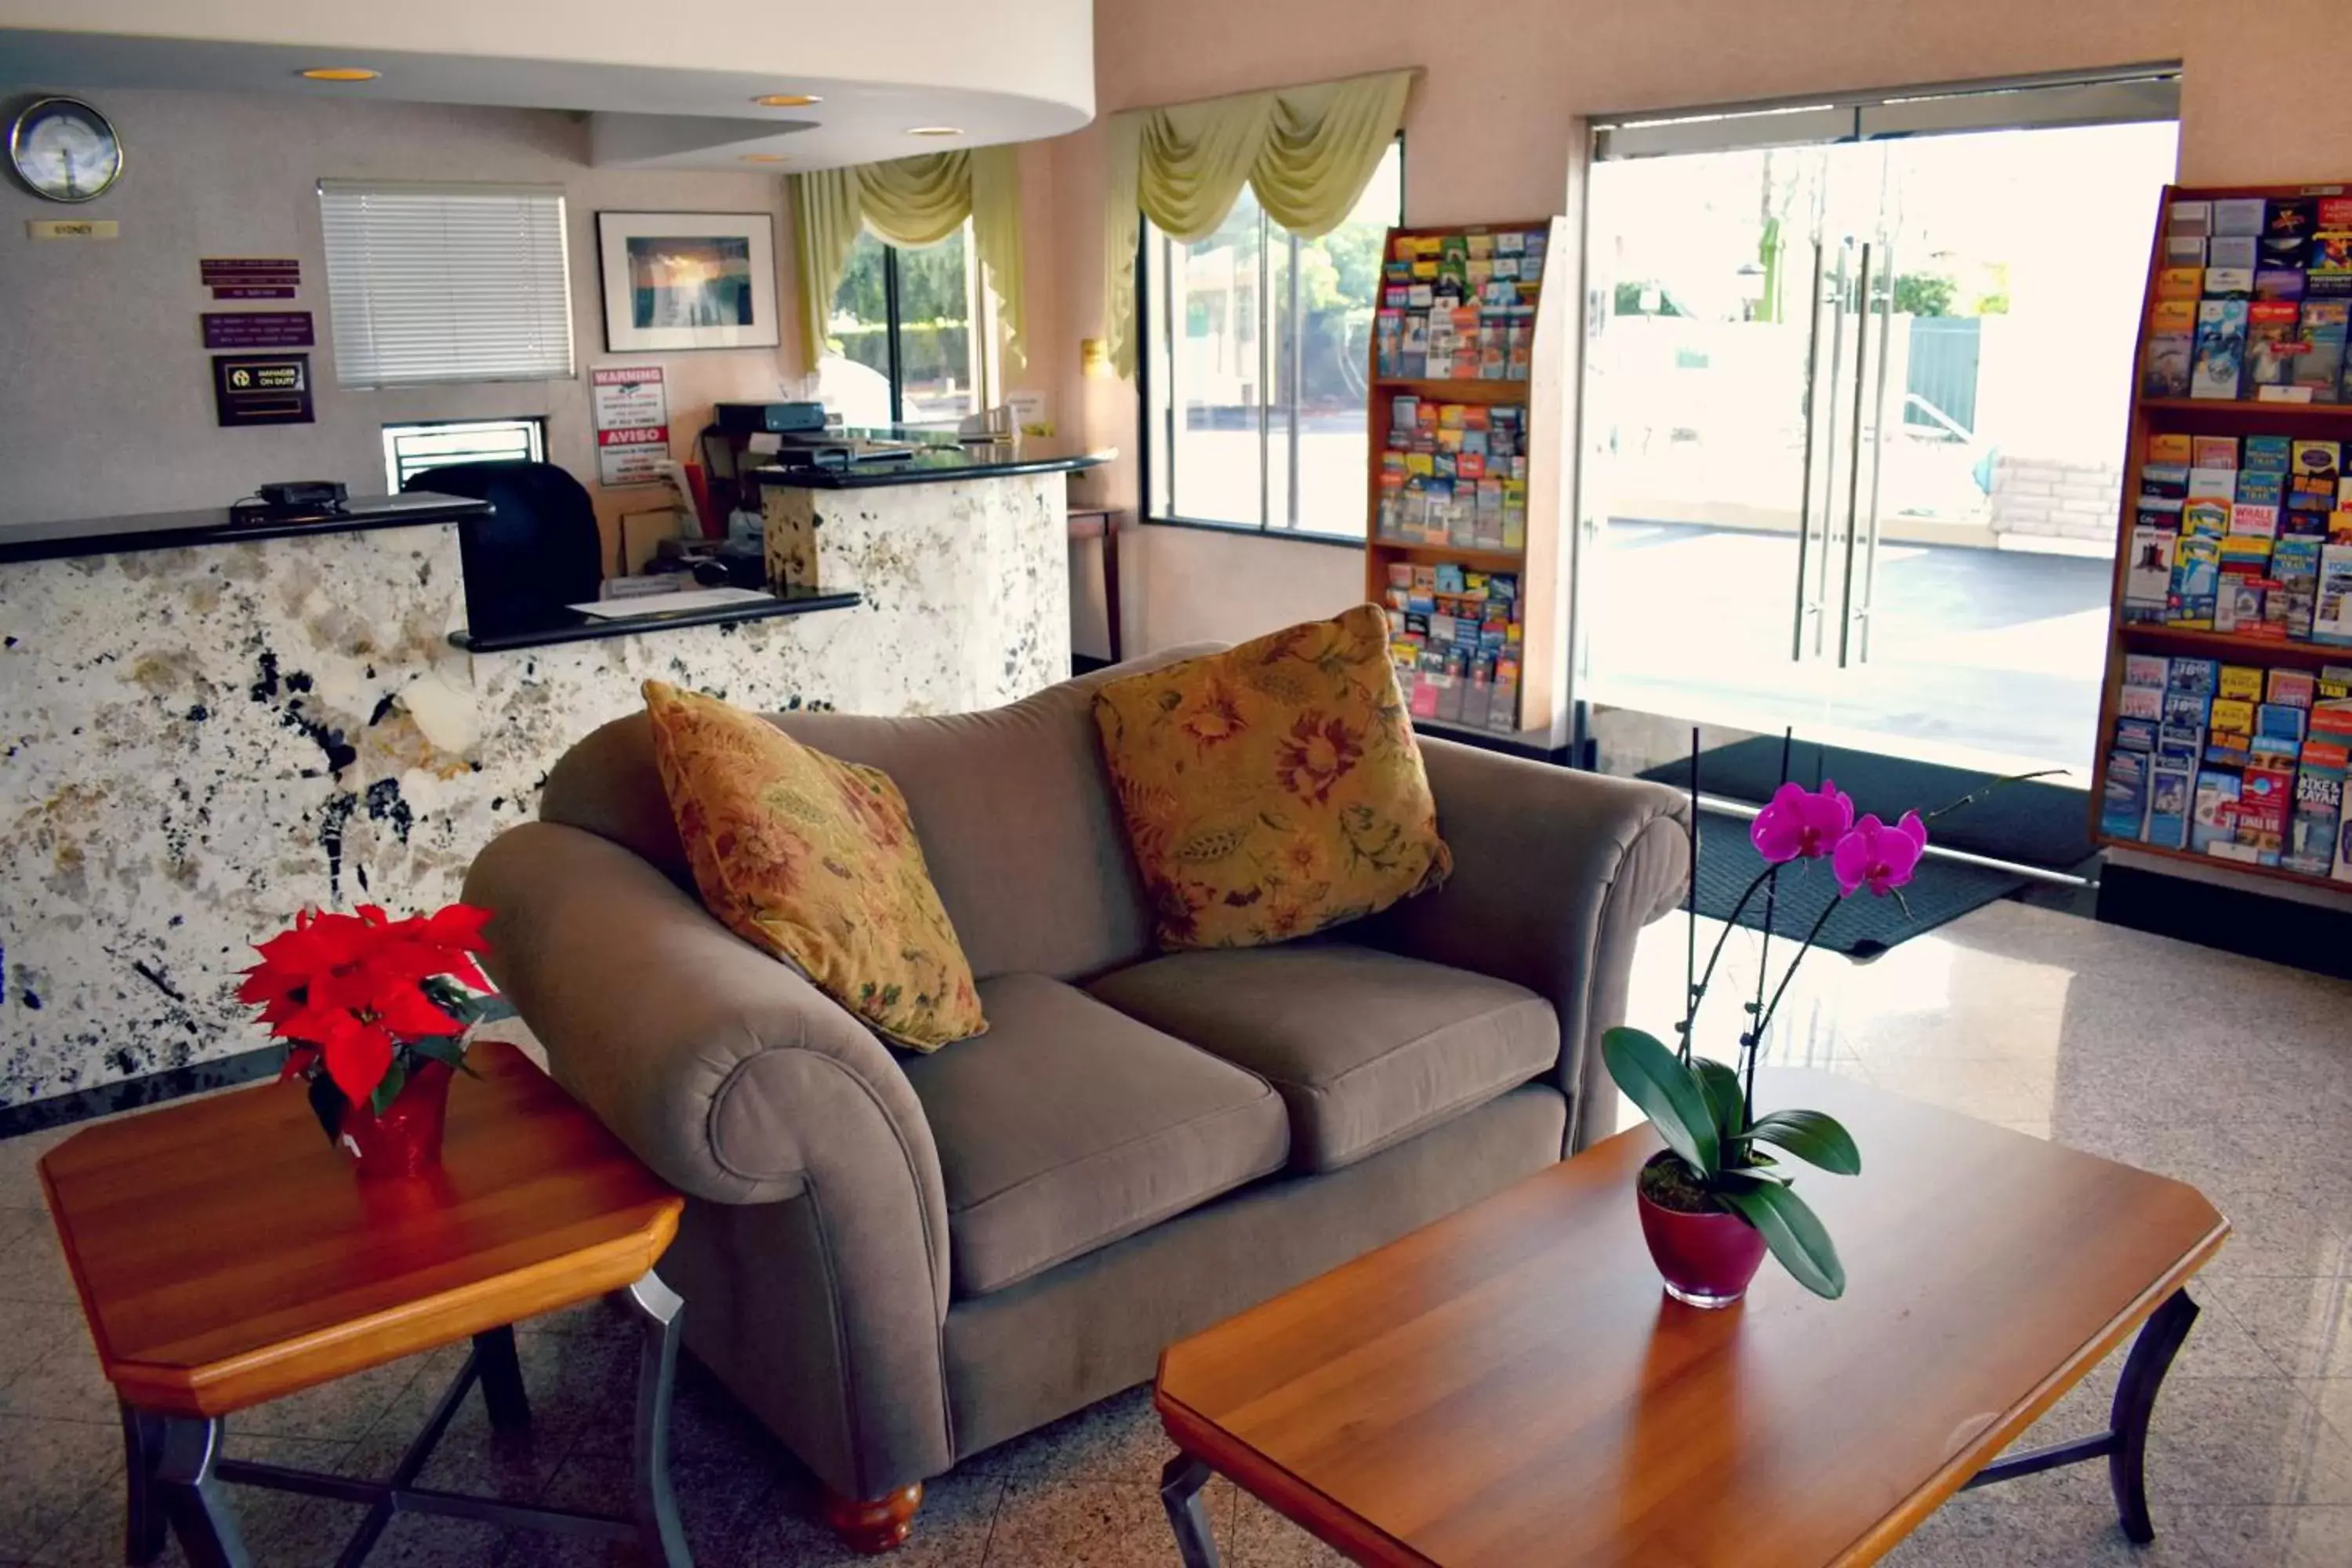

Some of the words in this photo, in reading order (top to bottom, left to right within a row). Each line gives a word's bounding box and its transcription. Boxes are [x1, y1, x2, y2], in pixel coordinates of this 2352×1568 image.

[258, 368, 296, 377] MANAGER
[595, 369, 660, 383] WARNING
[275, 377, 295, 386] DUTY
[607, 428, 660, 444] AVISO
[2234, 506, 2273, 518] WHALE
[2298, 777, 2329, 792] BIKE
[2296, 787, 2340, 806] KAYAK
